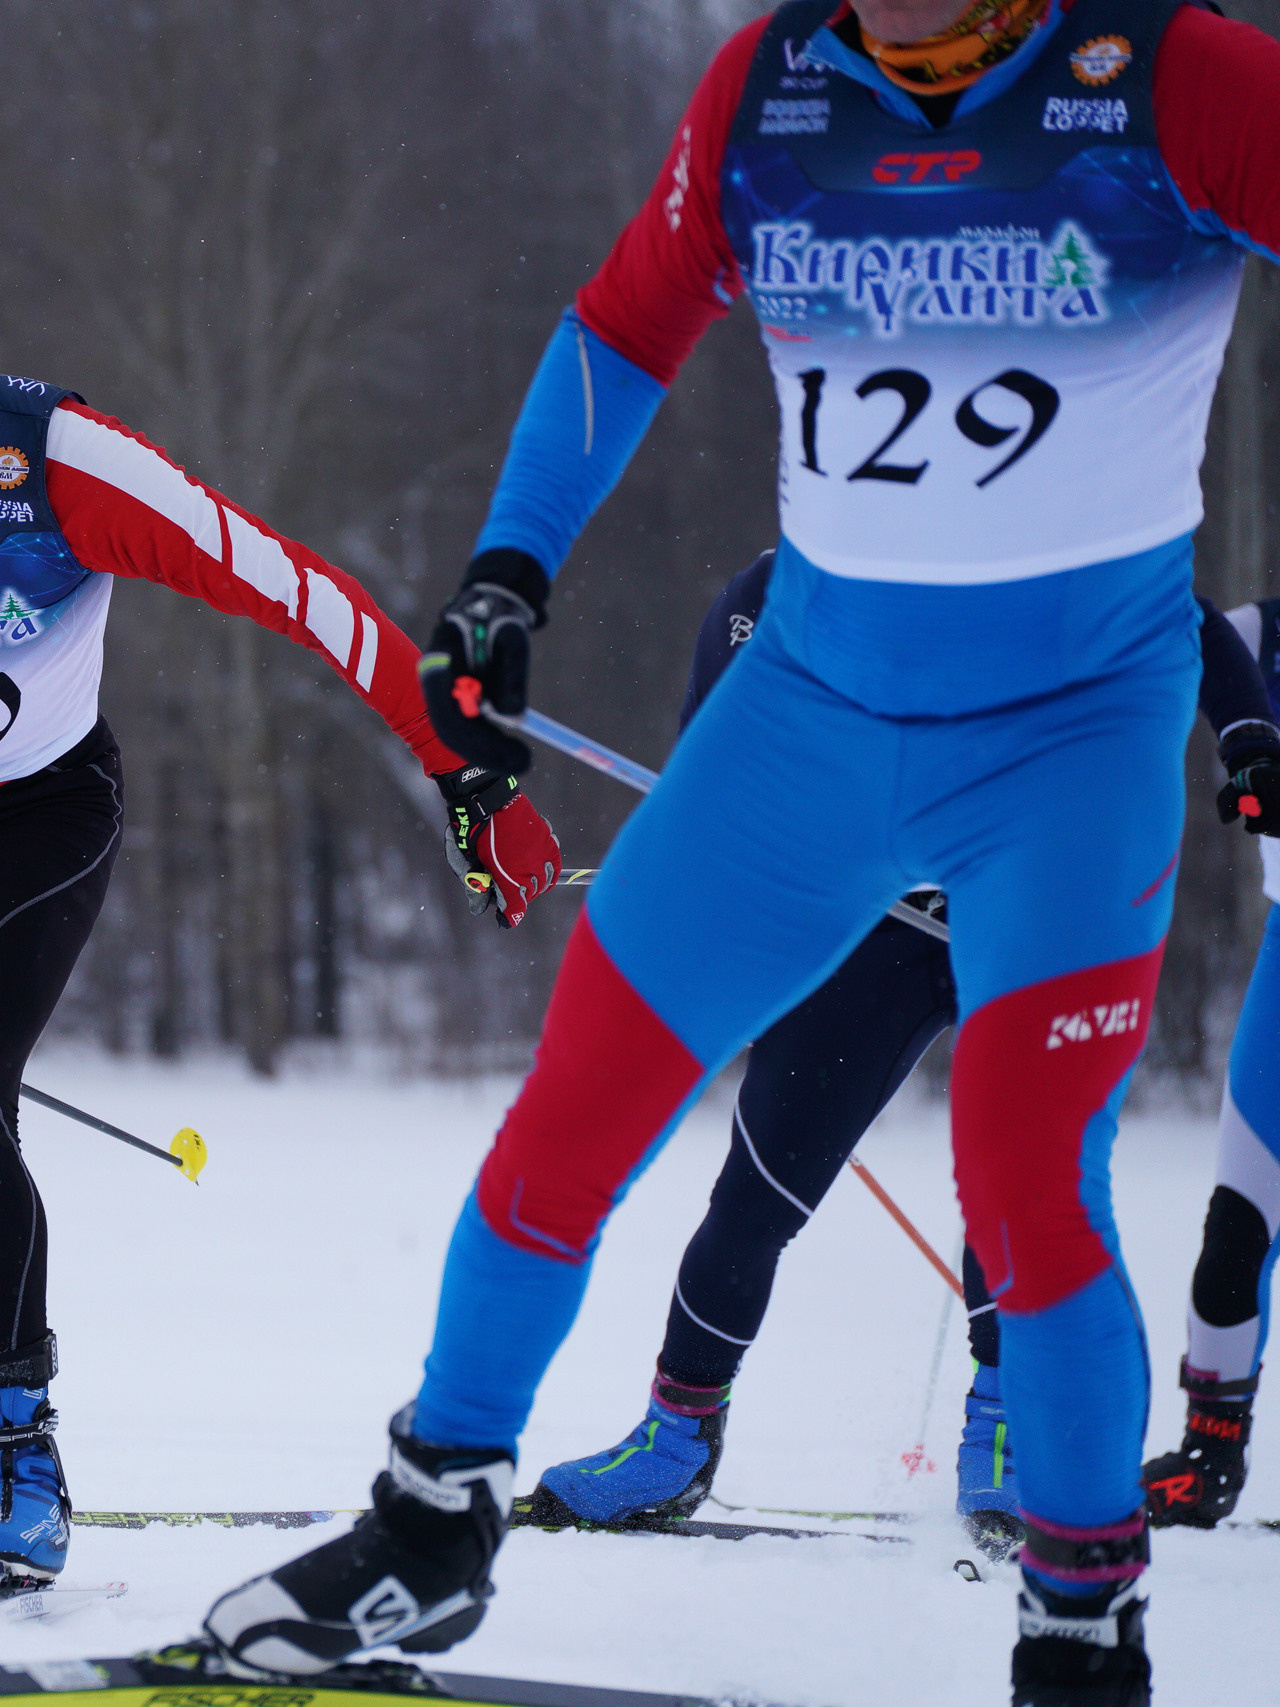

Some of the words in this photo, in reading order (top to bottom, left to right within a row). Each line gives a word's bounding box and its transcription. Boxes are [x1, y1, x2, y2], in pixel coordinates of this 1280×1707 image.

[795, 367, 1061, 489] 129
[455, 807, 470, 849] LEKI
[19, 1503, 60, 1544] SPINE
